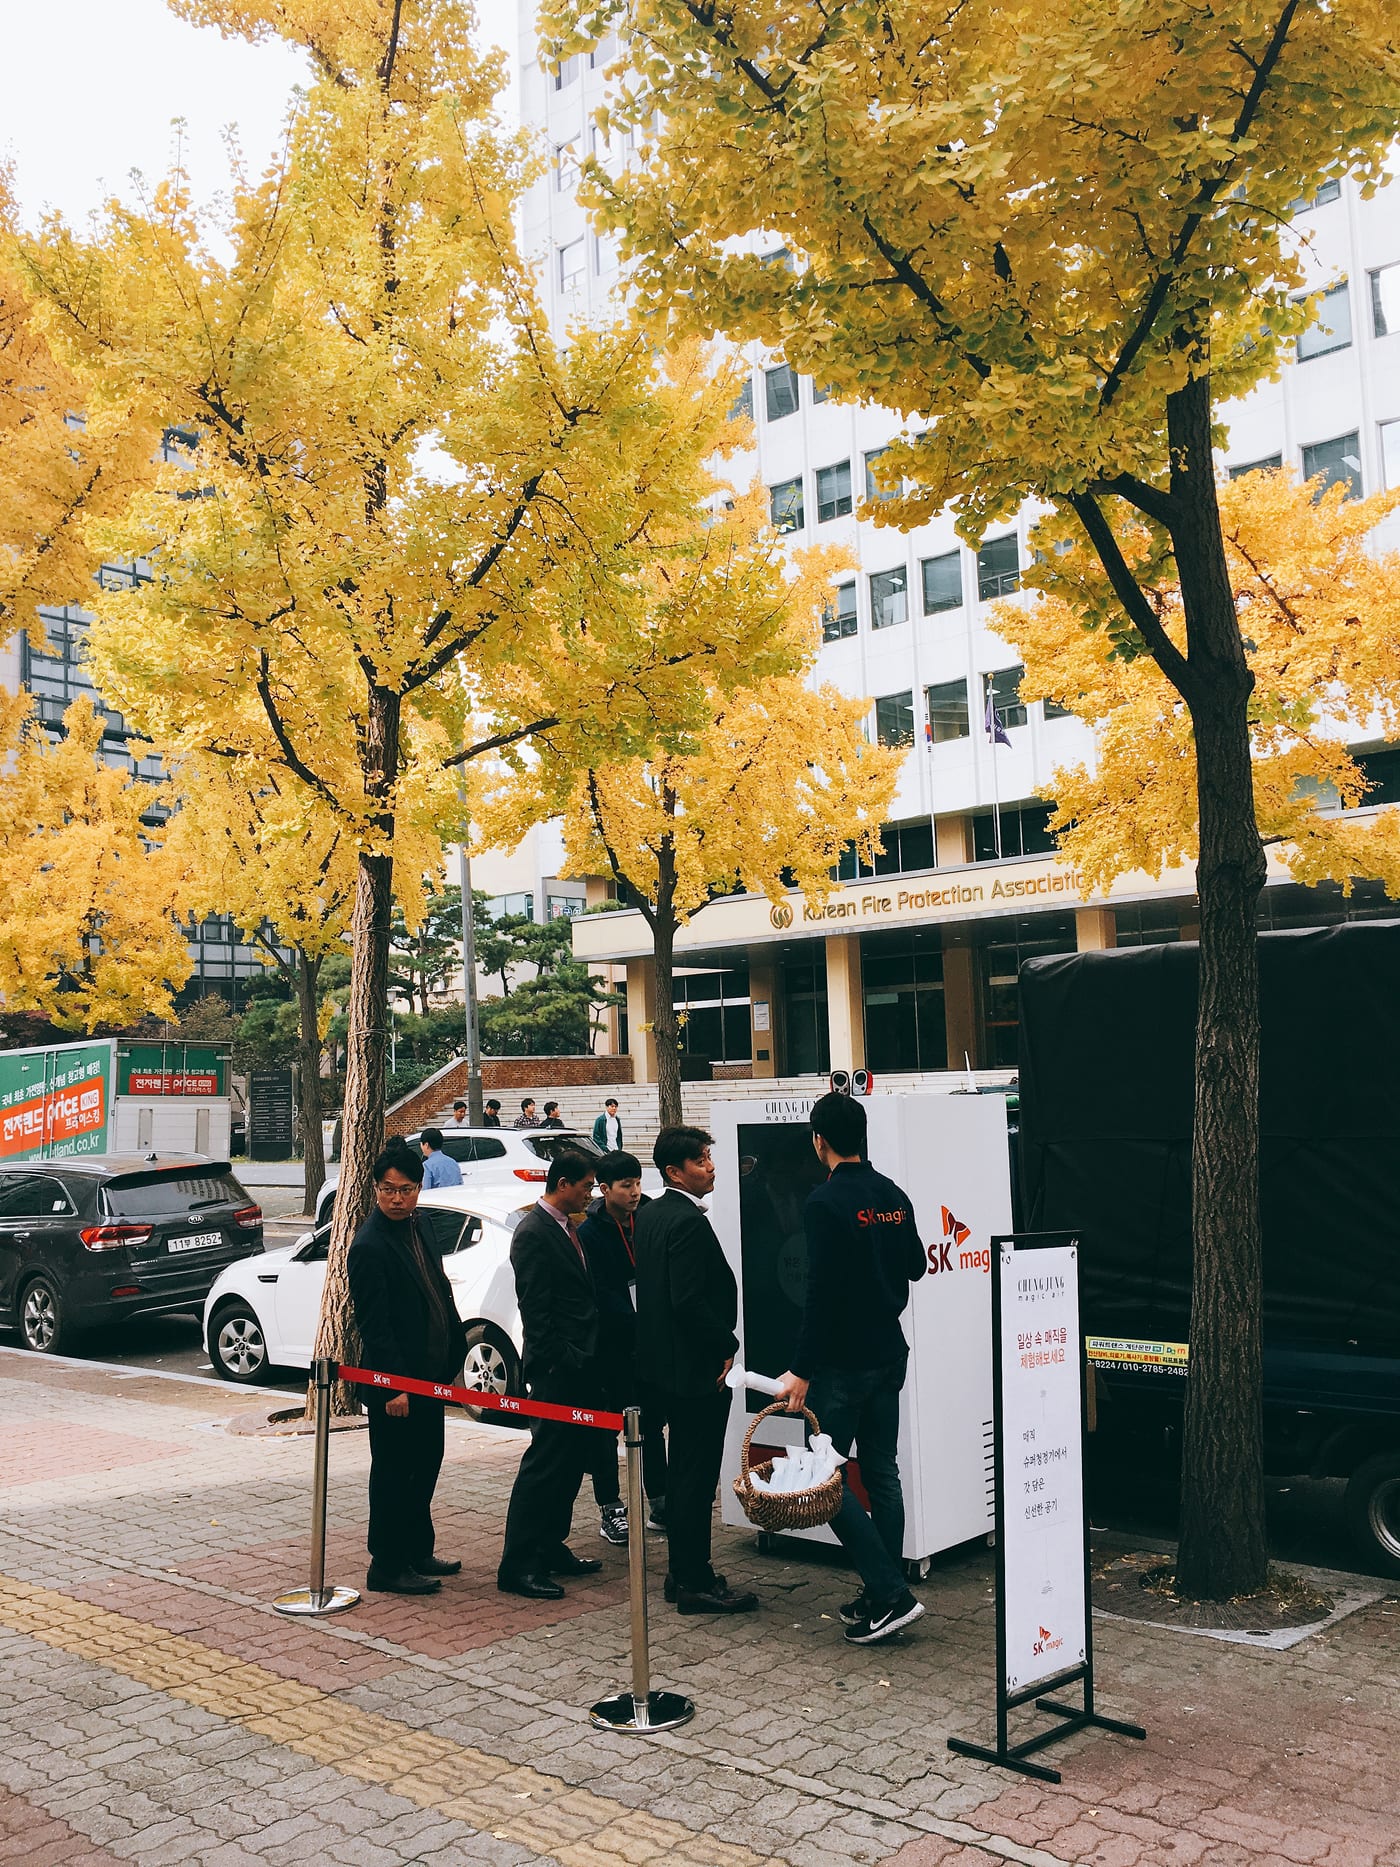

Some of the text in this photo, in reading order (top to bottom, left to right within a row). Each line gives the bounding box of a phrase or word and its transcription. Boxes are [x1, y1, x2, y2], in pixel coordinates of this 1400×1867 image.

[862, 895, 892, 915] Fire
[897, 885, 984, 911] Protection
[991, 869, 1101, 900] Associatio
[765, 1100, 816, 1114] CHUNG JU
[3, 1107, 44, 1141] 전자랜드
[65, 1109, 100, 1130] 프라이스킹
[194, 1234, 218, 1247] 8252
[927, 1242, 990, 1275] SK mag
[1018, 1276, 1065, 1292] CHUNG JUNG
[1018, 1291, 1065, 1303] magic air
[1018, 1327, 1067, 1350] 일상 속 매직을
[1021, 1348, 1066, 1369] 체험해보세요
[1122, 1362, 1189, 1377] 010-2785-2482
[373, 1374, 382, 1384] SK
[433, 1385, 443, 1396] SK
[500, 1398, 520, 1411] SK 매직
[572, 1409, 594, 1423] SK 매직
[1022, 1428, 1036, 1442] 매직
[1023, 1445, 1067, 1469] 슈퍼청정기에서
[1024, 1477, 1046, 1495] 갓 담은
[1025, 1498, 1058, 1520] 신선한 공기
[1033, 1637, 1063, 1656] SK magic
